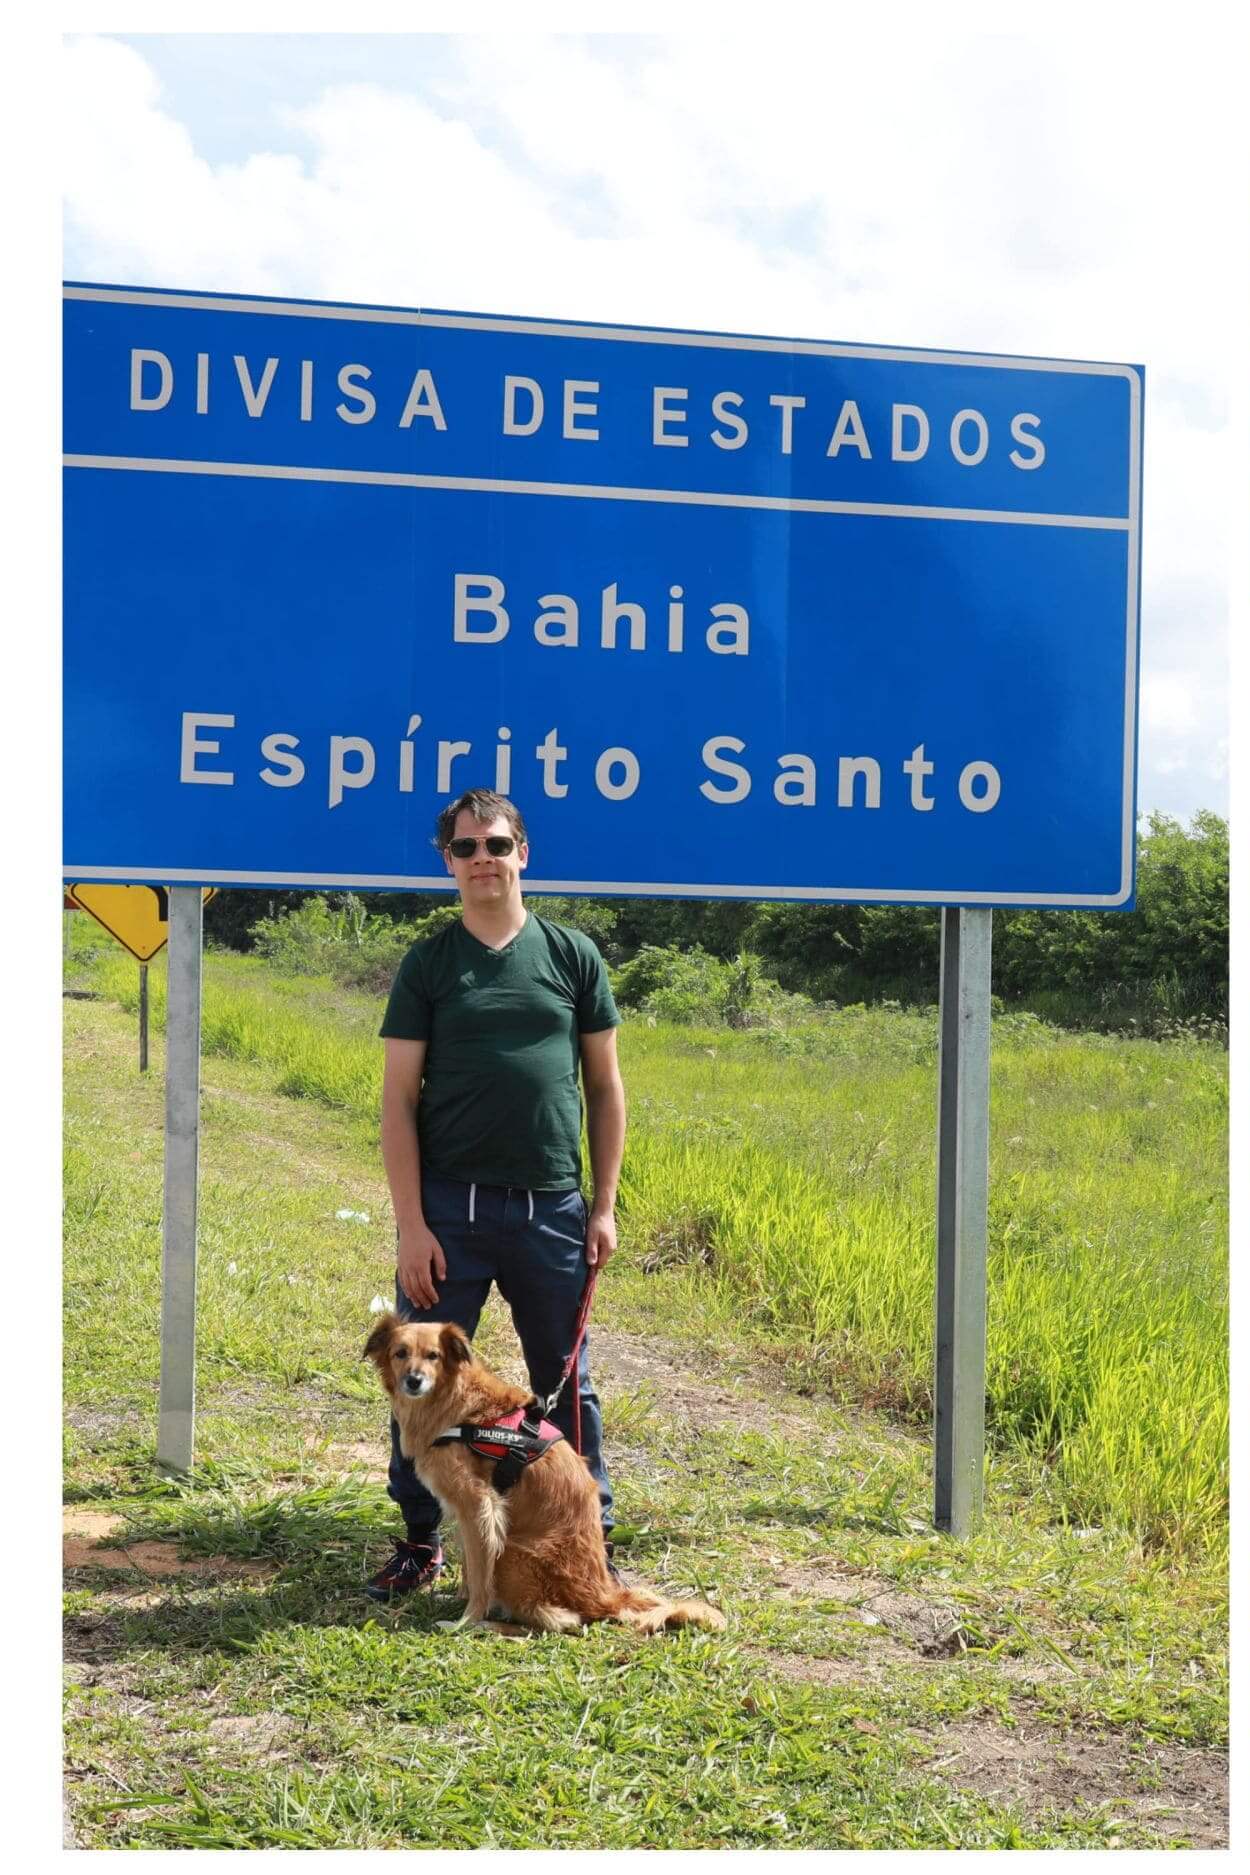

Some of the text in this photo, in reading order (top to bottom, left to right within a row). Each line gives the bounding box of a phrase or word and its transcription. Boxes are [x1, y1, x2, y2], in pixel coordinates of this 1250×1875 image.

[130, 348, 1047, 471] DIVISA DE ESTADOS
[453, 573, 750, 656] Bahia
[179, 711, 1003, 813] Espírito Santo
